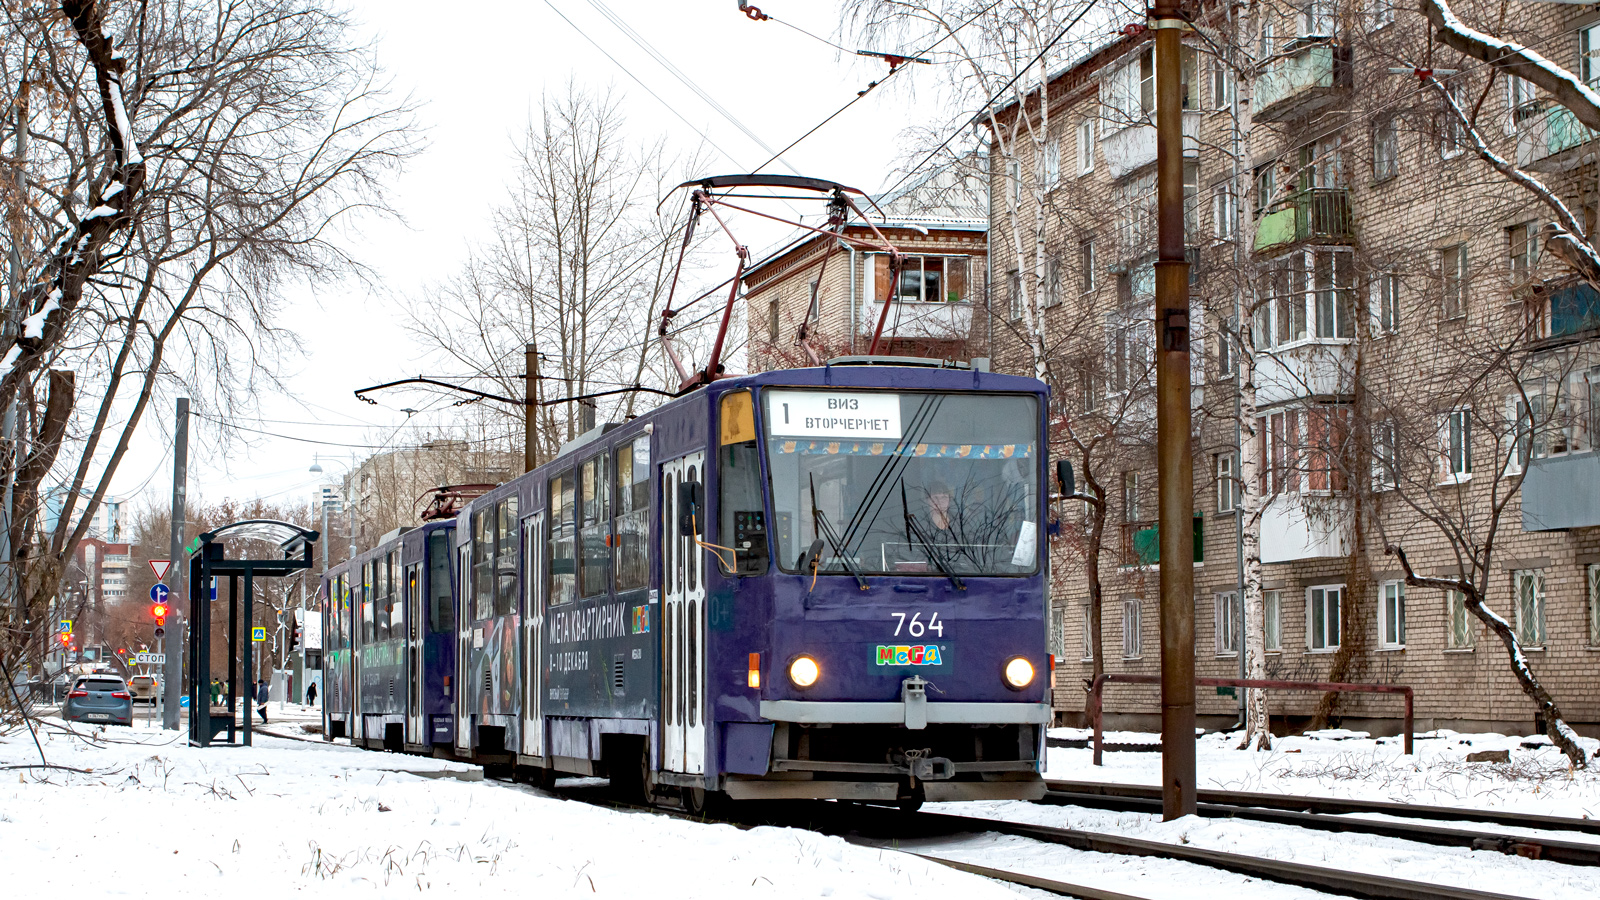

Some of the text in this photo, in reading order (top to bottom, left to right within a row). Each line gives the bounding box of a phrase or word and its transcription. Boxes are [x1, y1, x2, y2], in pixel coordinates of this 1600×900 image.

[782, 402, 790, 425] 1
[827, 398, 859, 410] ВИЗ
[805, 417, 889, 431] ВТОРЧЕРМЕТ
[549, 602, 626, 645] МЕГА КВАРТИРНИК
[891, 611, 944, 638] 764
[138, 654, 164, 662] СТОП
[563, 651, 588, 675] ДЕКАБРЯ
